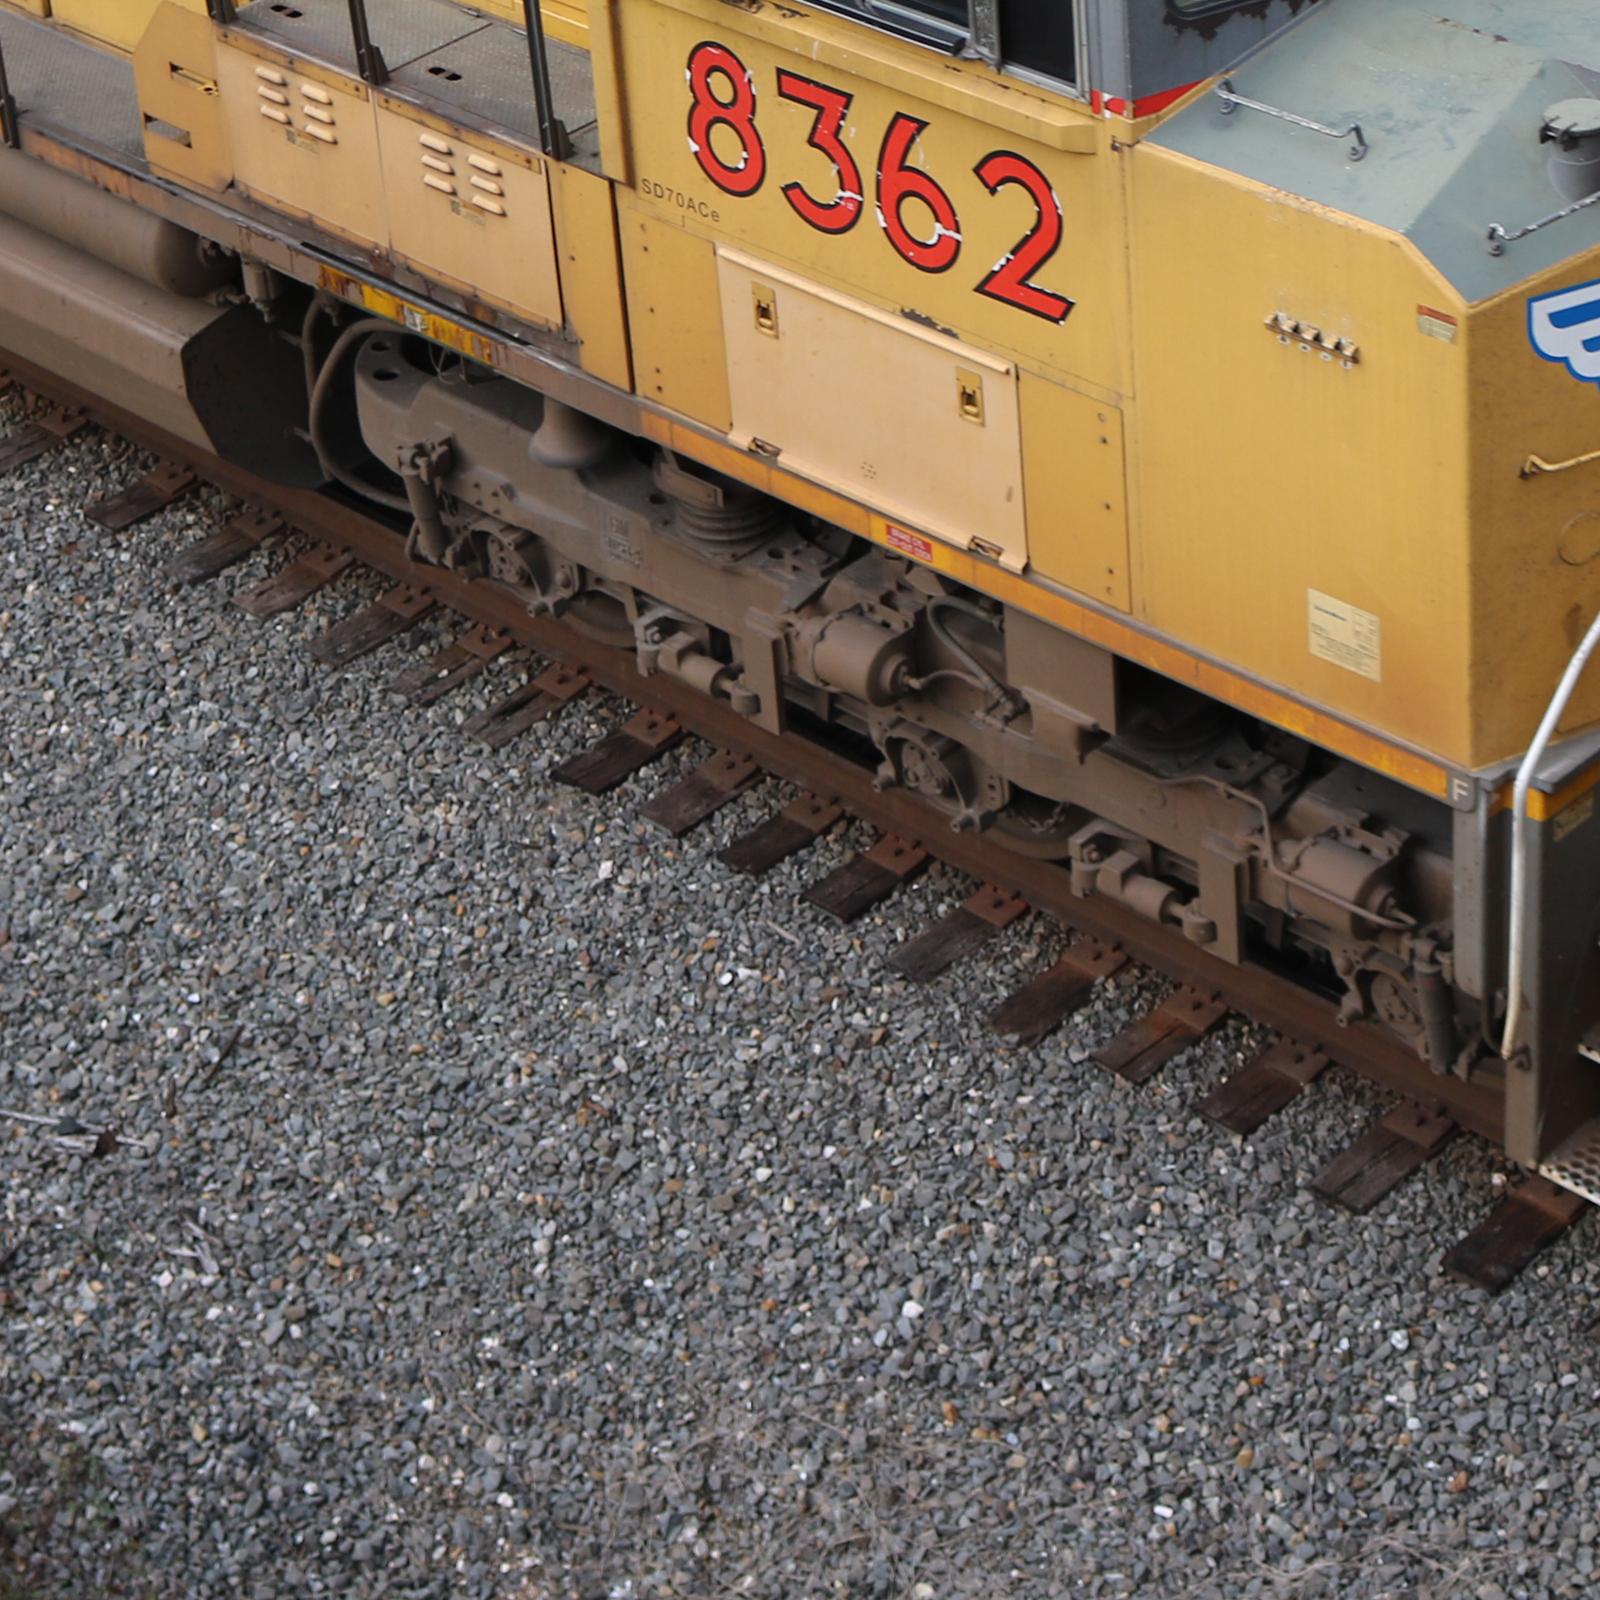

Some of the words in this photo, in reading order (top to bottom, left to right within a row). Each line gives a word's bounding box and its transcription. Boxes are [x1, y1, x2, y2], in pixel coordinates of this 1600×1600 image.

[641, 178, 721, 223] SD70ACe
[686, 40, 1076, 326] 8362
[1453, 779, 1468, 800] F
